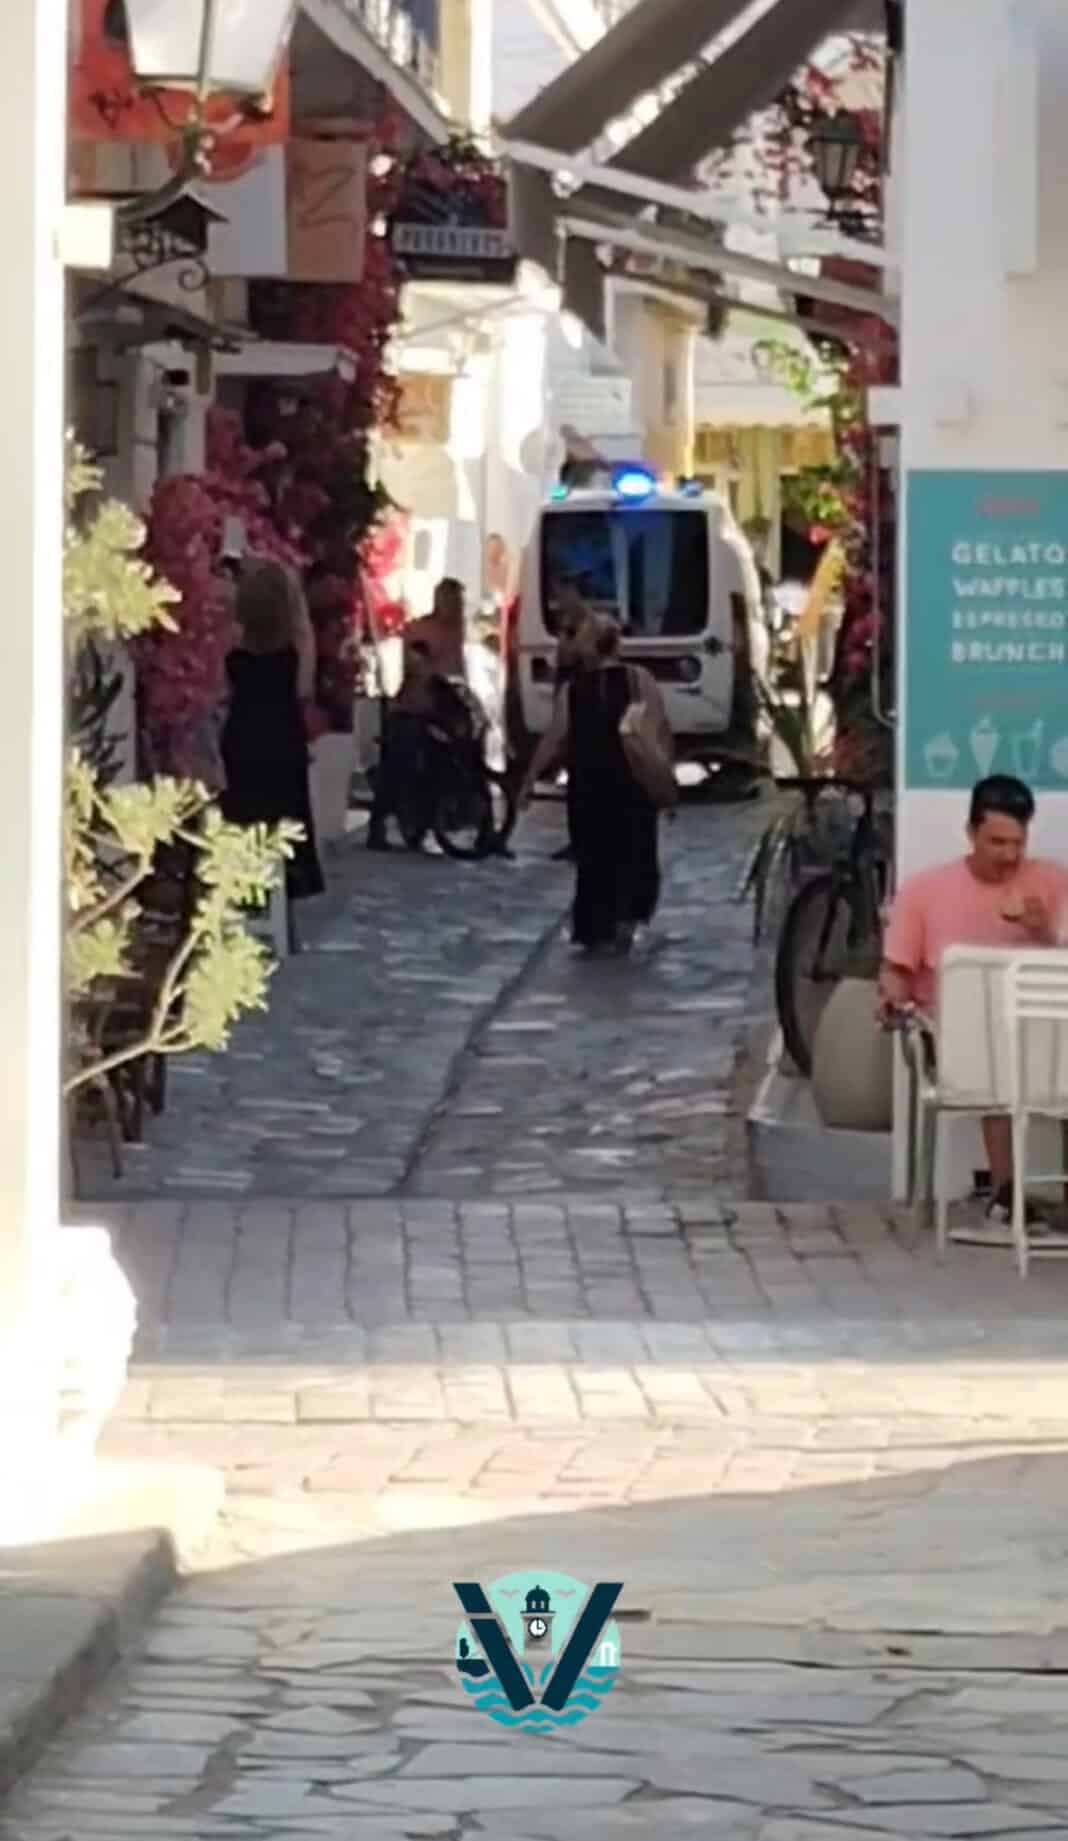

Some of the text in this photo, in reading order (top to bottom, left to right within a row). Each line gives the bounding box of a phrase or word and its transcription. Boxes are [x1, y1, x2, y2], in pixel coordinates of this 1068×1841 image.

[952, 541, 1066, 564] GELATO
[952, 577, 1065, 599] WAFFLES
[951, 641, 1065, 662] BRUNCH
